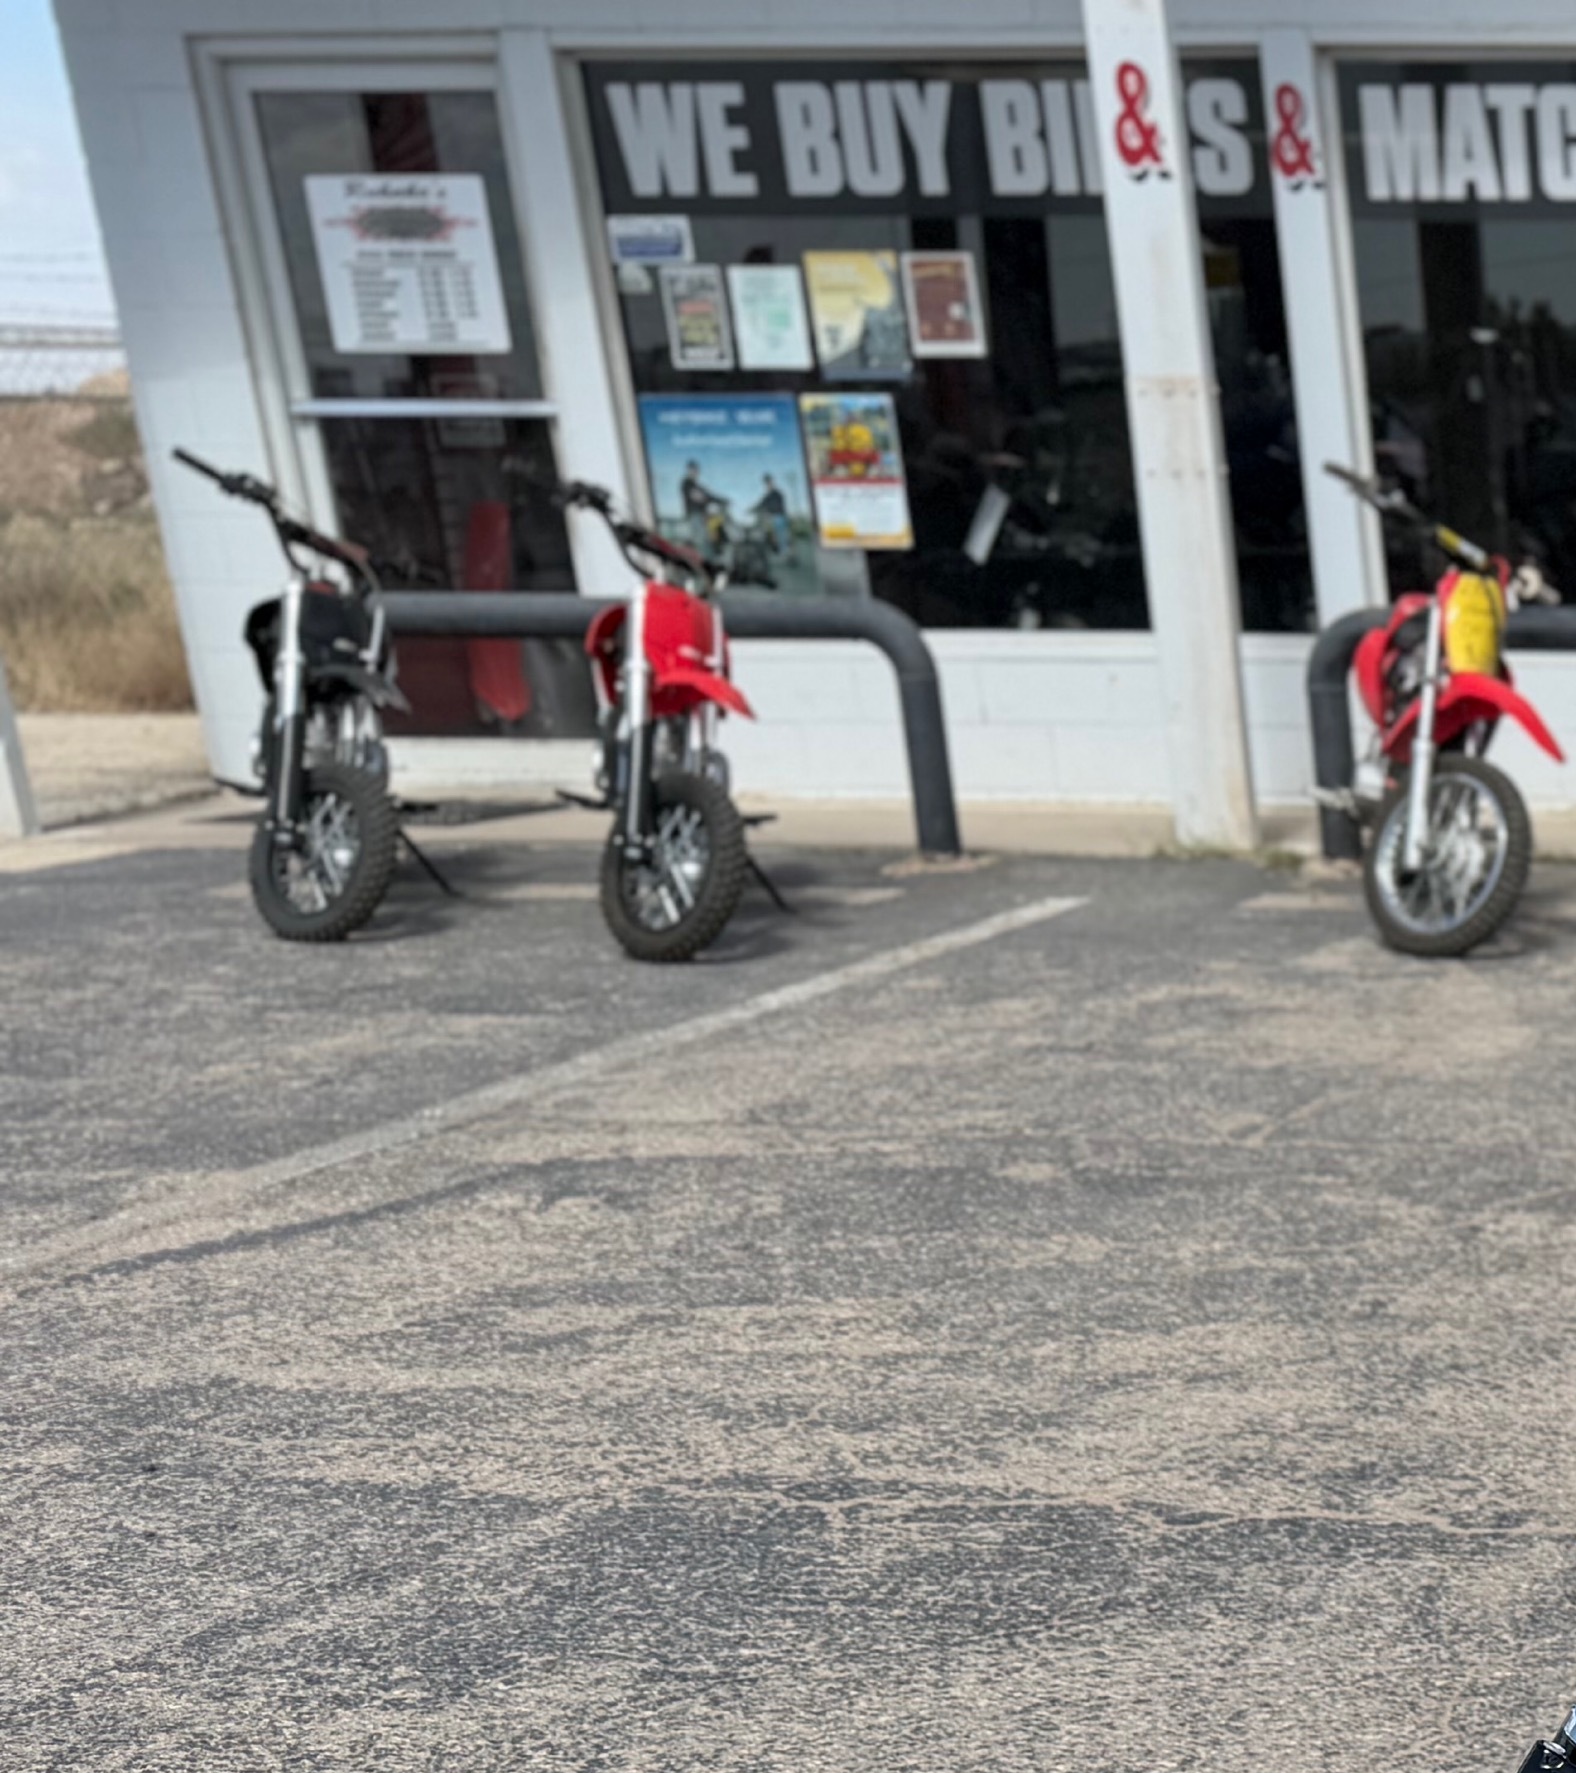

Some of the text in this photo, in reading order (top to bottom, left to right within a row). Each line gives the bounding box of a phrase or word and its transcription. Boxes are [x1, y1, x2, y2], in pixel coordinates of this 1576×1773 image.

[606, 78, 1254, 197] WE BUY BIS
[1115, 61, 1163, 168] &
[1270, 83, 1316, 178] &
